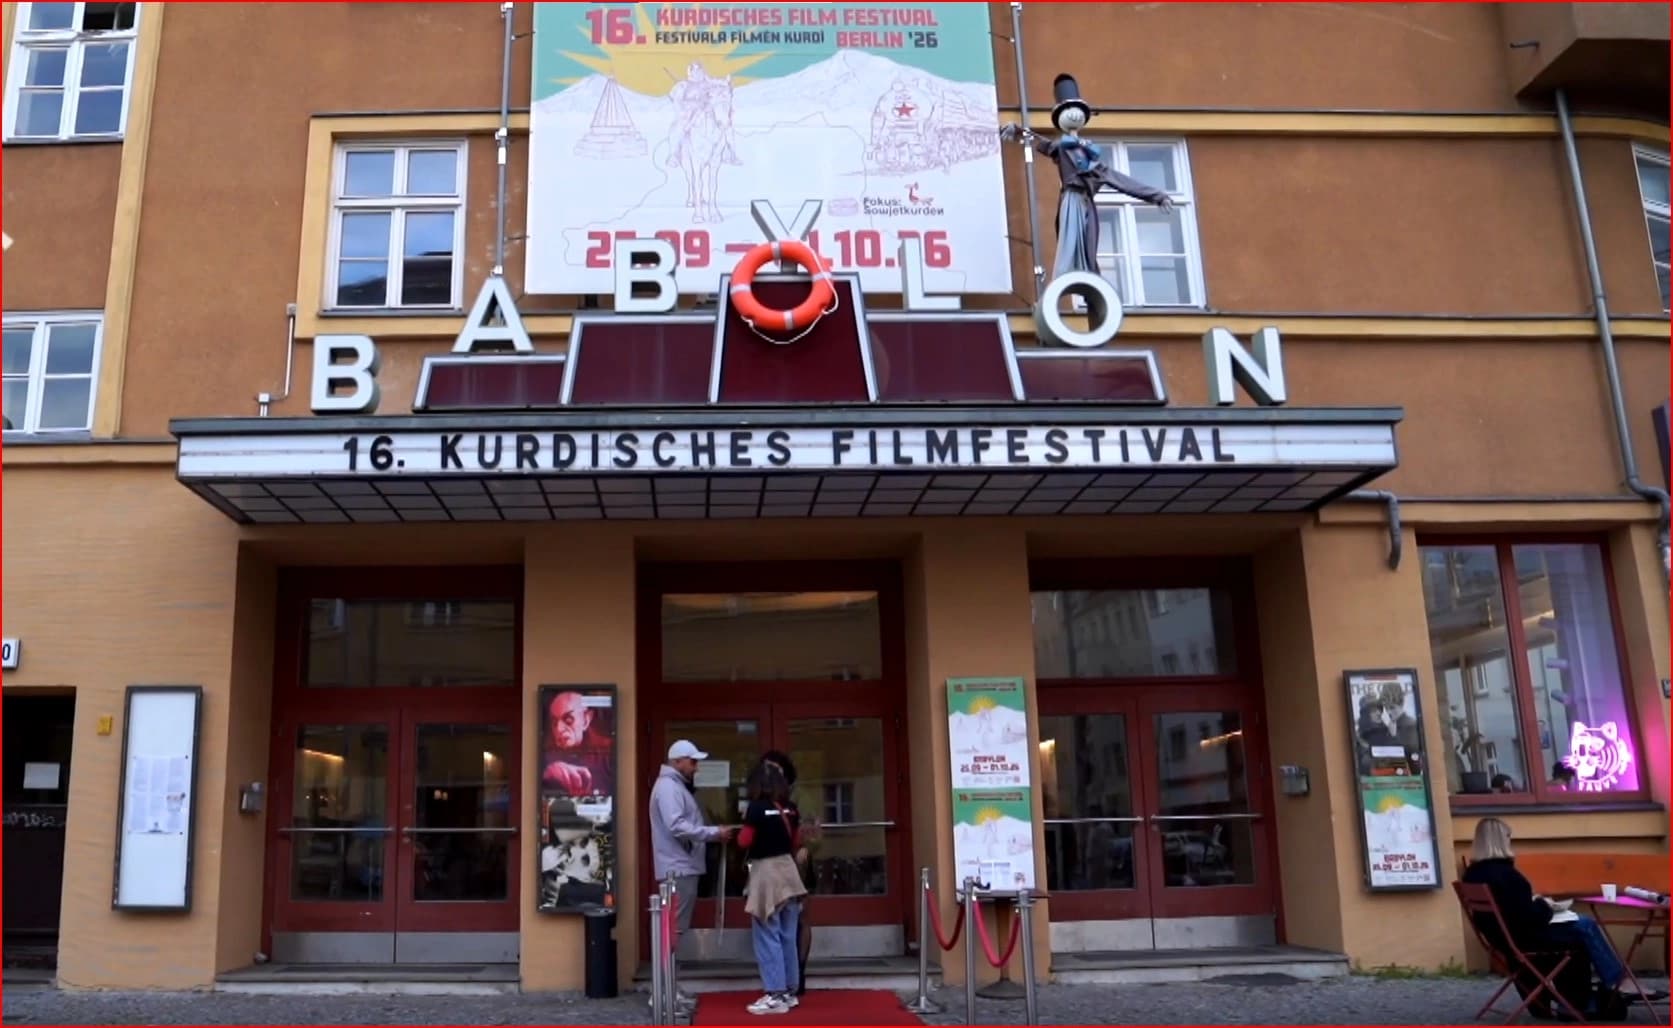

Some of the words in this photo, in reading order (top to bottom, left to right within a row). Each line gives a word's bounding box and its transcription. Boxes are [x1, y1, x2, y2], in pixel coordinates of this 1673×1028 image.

[586, 9, 647, 44] 16.
[657, 9, 782, 26] KURDISCHES
[788, 9, 837, 26] FILM
[843, 9, 938, 26] FESTIVAL
[836, 32, 903, 48] BERLIN
[343, 436, 405, 471] 16.
[440, 430, 792, 469] KURDISCHES
[832, 428, 1235, 465] FILMFESTIVAL
